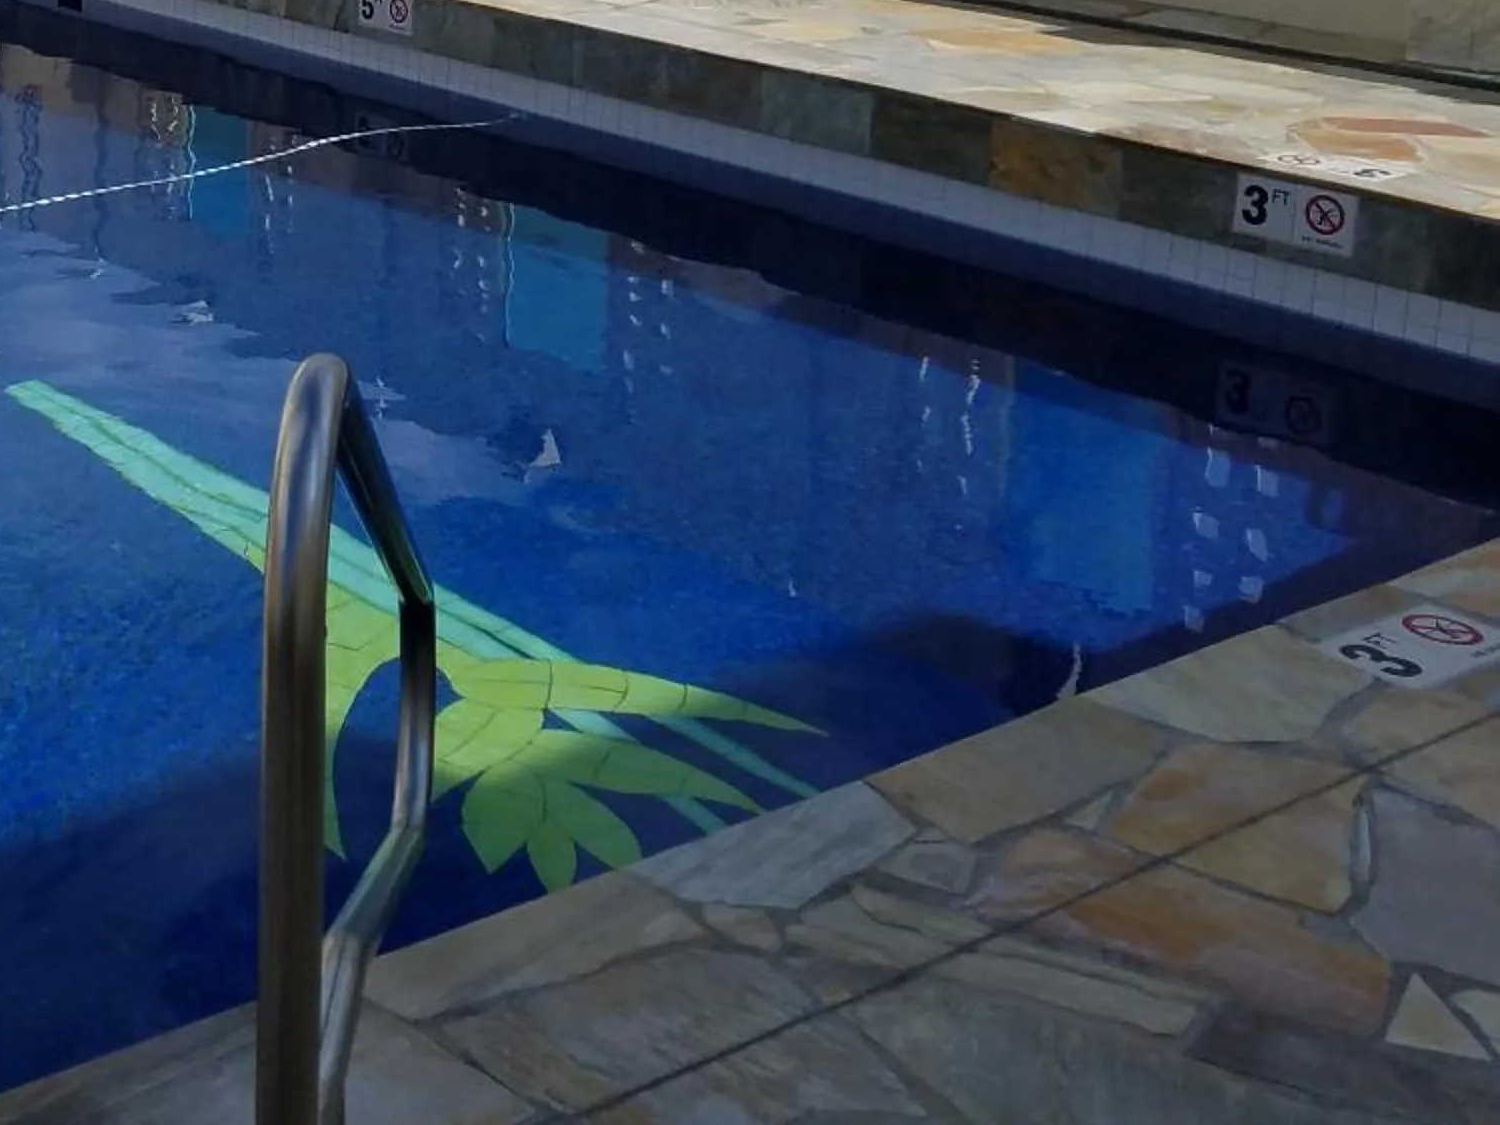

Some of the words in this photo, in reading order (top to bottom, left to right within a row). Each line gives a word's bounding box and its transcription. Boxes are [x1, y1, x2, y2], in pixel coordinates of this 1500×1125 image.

[1241, 184, 1269, 226] 3
[1271, 188, 1291, 206] FT
[1363, 632, 1397, 649] FT
[1339, 644, 1424, 677] 3
